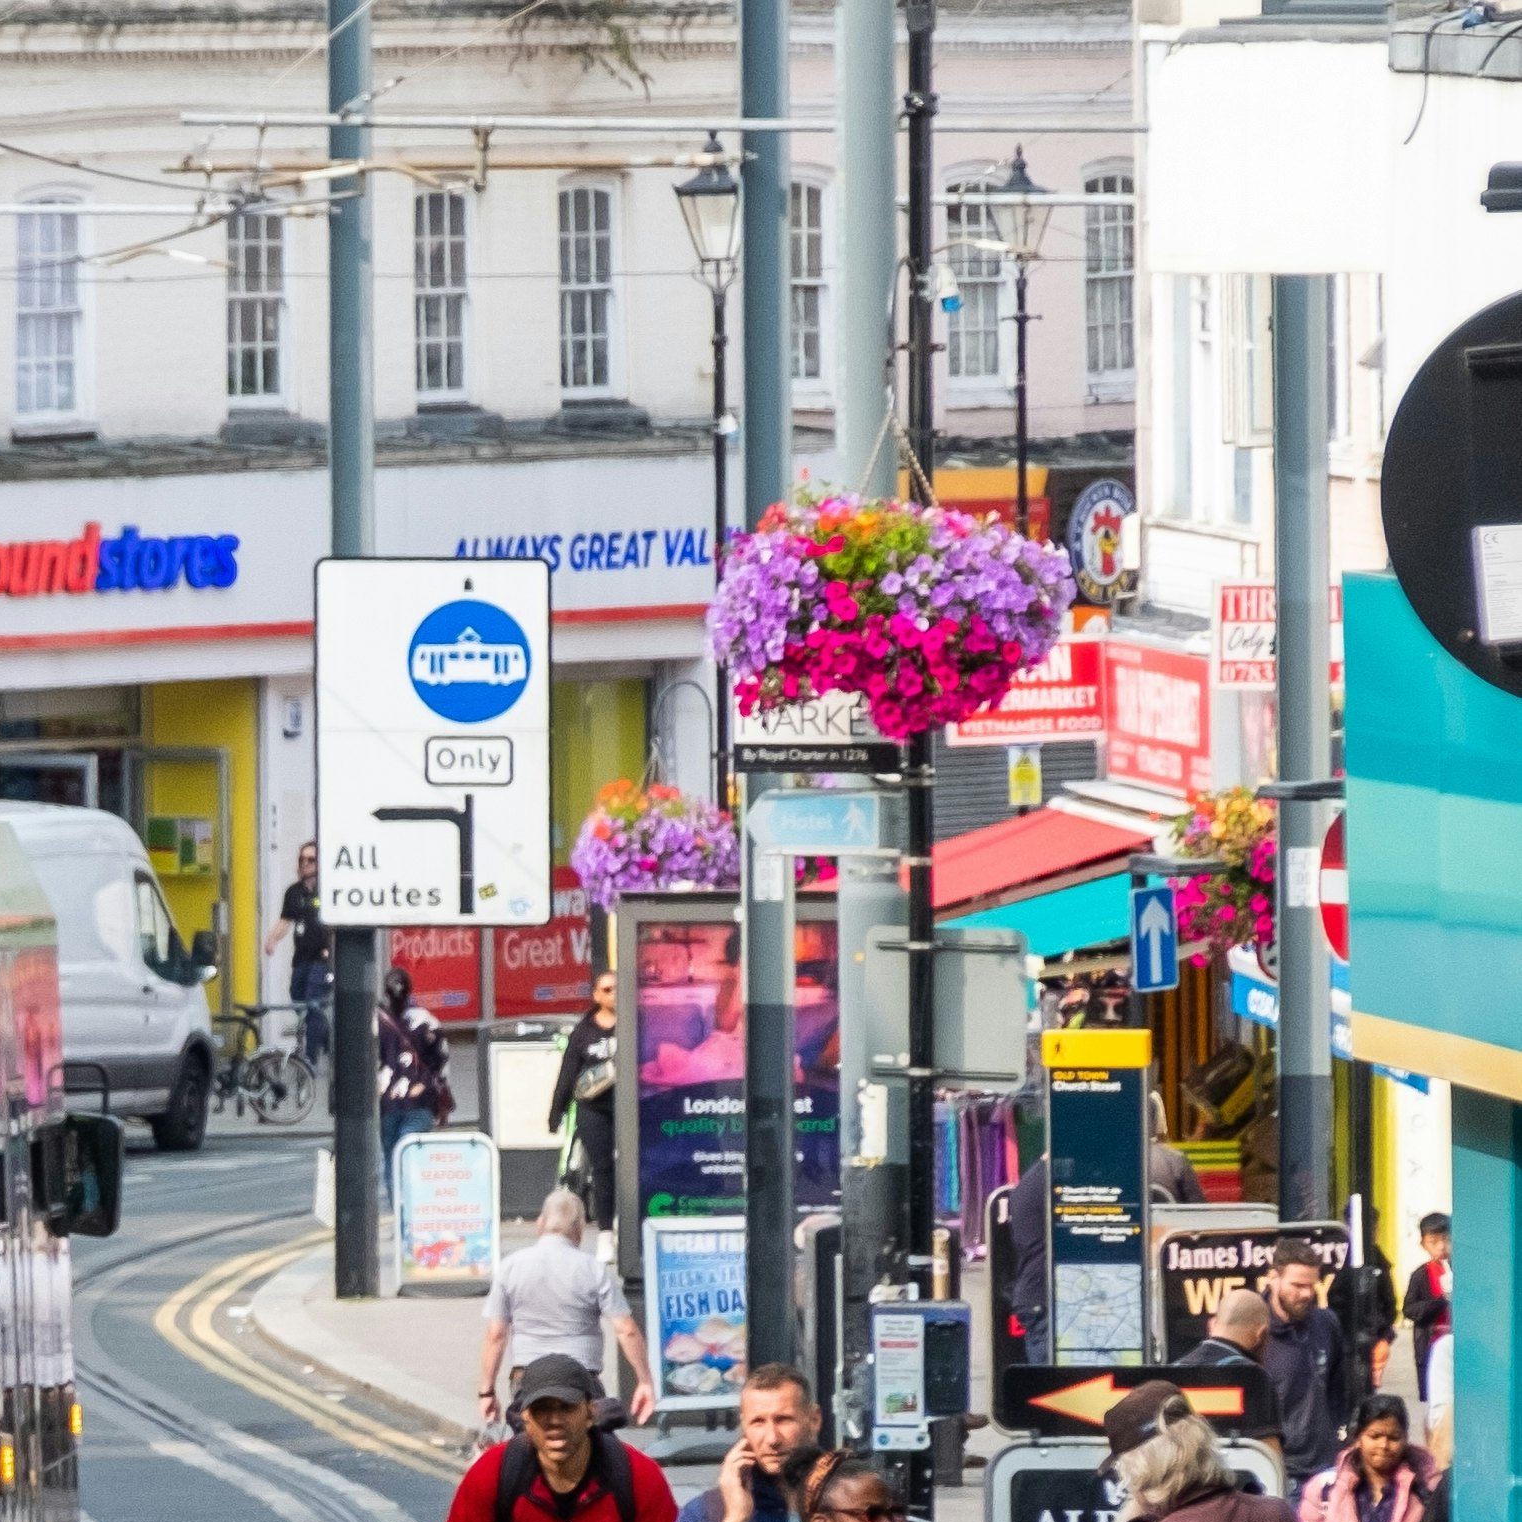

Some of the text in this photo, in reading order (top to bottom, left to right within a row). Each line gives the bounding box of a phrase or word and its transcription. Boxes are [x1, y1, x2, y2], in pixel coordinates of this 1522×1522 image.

[569, 530, 657, 571] GREAT
[664, 528, 712, 567] VAL
[1221, 587, 1277, 621] THR
[1228, 626, 1265, 658] Only
[997, 685, 1098, 711] ERMARKET
[740, 703, 869, 736] MARKE
[1057, 716, 1102, 731] FOOD
[436, 747, 501, 773] Only
[759, 749, 786, 762] Royal
[788, 749, 827, 761] Charter
[333, 844, 380, 870] All
[331, 882, 443, 908] routes
[391, 928, 476, 959] Products
[504, 930, 565, 970] Great
[1053, 1071, 1109, 1081] OLD TOWN
[683, 1097, 747, 1115] Londo
[661, 1117, 726, 1138] quality
[1167, 1239, 1350, 1272] James Jewery
[721, 1266, 746, 1285] FR
[665, 1287, 745, 1319] FISH DA
